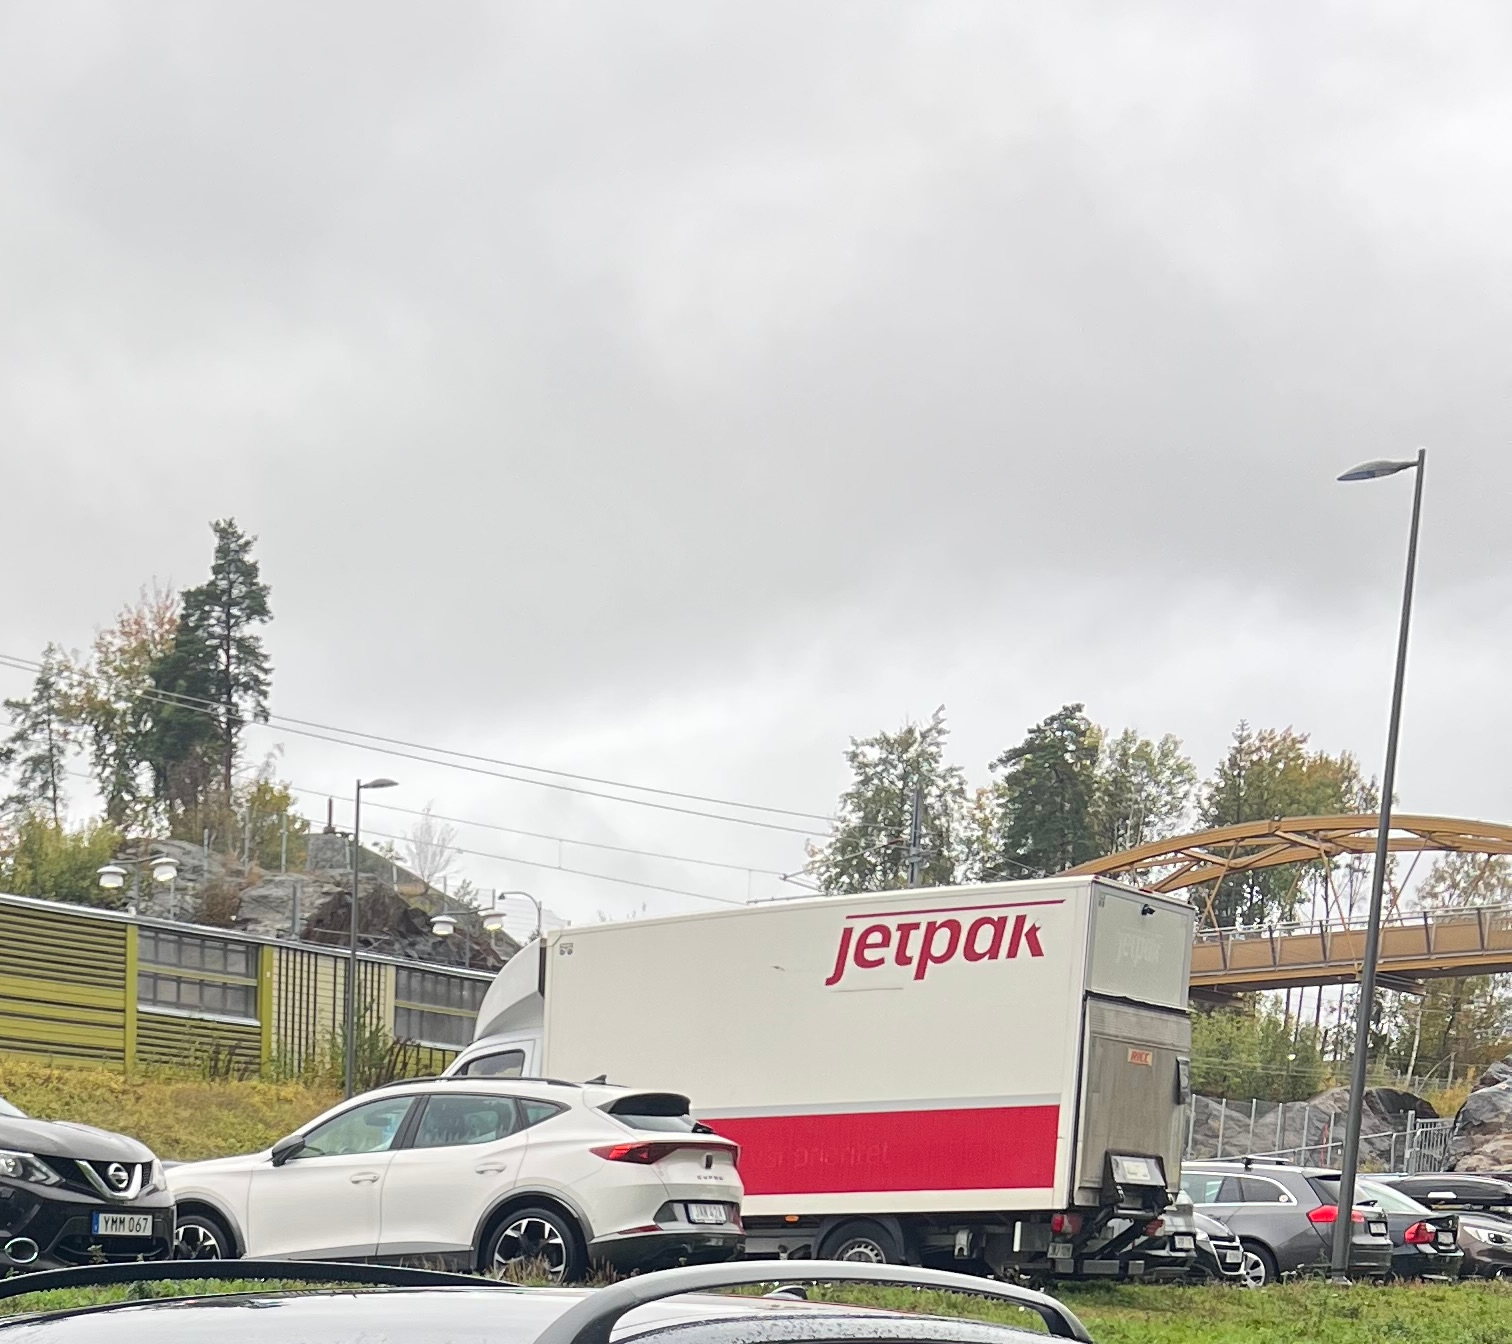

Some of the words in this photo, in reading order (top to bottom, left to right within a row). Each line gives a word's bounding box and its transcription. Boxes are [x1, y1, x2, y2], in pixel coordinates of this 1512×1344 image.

[825, 914, 1044, 986] jetpak
[103, 1215, 126, 1232] YMM
[128, 1216, 148, 1233] 067
